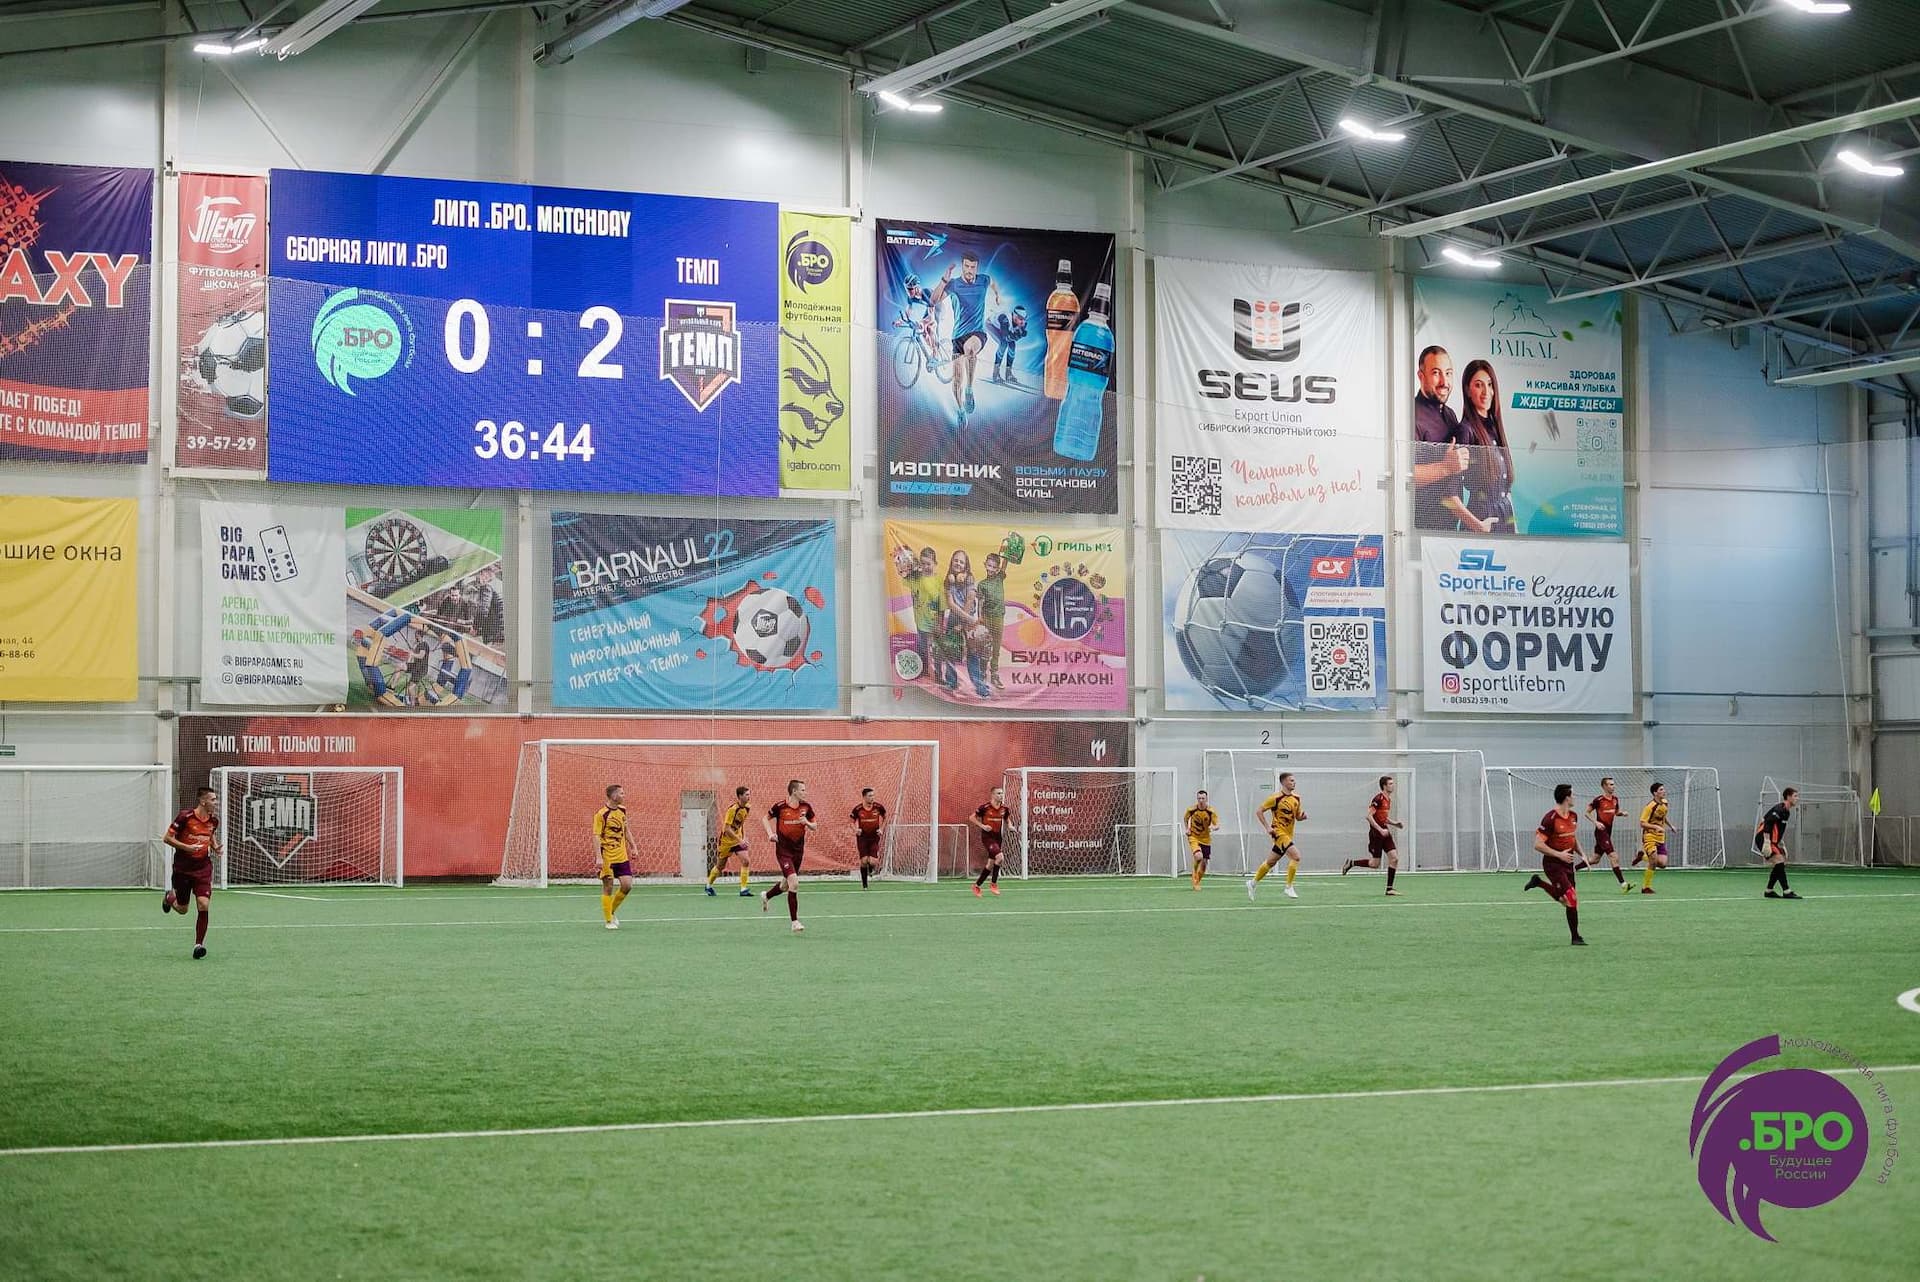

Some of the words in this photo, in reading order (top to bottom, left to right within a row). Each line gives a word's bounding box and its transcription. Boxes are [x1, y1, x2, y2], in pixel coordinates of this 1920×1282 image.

[432, 198, 480, 228] ЛИГА
[484, 202, 533, 232] .БРО.
[536, 205, 633, 238] MATCHDAY
[285, 236, 362, 264] СБОРНАЯ
[365, 239, 409, 267] ЛИГИ
[411, 243, 449, 270] .БРО
[797, 253, 830, 269] .БРО
[188, 265, 258, 279] ФУТБОЛЬНАЯ
[676, 256, 720, 286] ТЕМП
[203, 279, 241, 291] ШКОЛА
[784, 311, 843, 324] футбольная
[336, 326, 394, 350] .БРО
[819, 324, 842, 335] лига
[444, 299, 491, 374] 0
[577, 305, 624, 379] 2
[668, 331, 734, 371] ТЕМП
[1569, 369, 1616, 381] ЗДОРОВАЯ
[1197, 368, 1337, 404] SEUS
[1526, 380, 1533, 390] И
[1534, 381, 1580, 393] КРАСИВАЯ
[1582, 384, 1616, 394] УЛЫБКА
[33, 395, 81, 418] ПОБЕД!
[1519, 395, 1549, 409] ЖДЕТ
[1552, 397, 1578, 410] ТЕБЯ
[1579, 399, 1616, 412] ЗДЕСЬ!
[1234, 408, 1269, 423] Export
[1271, 411, 1302, 423] Union
[16, 416, 25, 433] С
[28, 417, 100, 441] КОМАНДОЙ
[104, 422, 141, 440] ТЕМП!
[1198, 422, 1251, 434] СИБИРСКИЙ
[1253, 425, 1312, 437] ЭКСПОРТНЫЙ
[1313, 428, 1337, 437] СОЮЗ
[187, 436, 257, 451] 39-57-29
[473, 418, 596, 463] 36:44
[786, 459, 842, 473] ligabro.com
[889, 461, 1001, 479] ИЗОТОНИК
[1015, 466, 1066, 476] ВОЗЬМИ
[1231, 457, 1305, 485] Чемпион
[1015, 478, 1097, 489] ВОССТАНОВИ
[1234, 482, 1305, 508] каждом
[1308, 484, 1327, 504] из
[1330, 469, 1362, 496] нас!
[1016, 488, 1055, 499] СИЛЫ.
[220, 527, 242, 543] BIG
[62, 544, 122, 562] окна
[221, 545, 255, 562] PAPA
[1057, 542, 1092, 551] ГРИЛЬ
[1457, 549, 1506, 571] SL
[222, 563, 266, 581] GAMES
[1439, 573, 1526, 592] SportLife
[1531, 575, 1619, 604] Создаем
[221, 596, 259, 611] АРЕНДА
[221, 613, 290, 628] РАЗВЛЕЧЕНИЙ
[1440, 603, 1615, 628] СПОРТИВНУЮ
[569, 612, 651, 644] ГЕНЕРАЛЬНЫЙ
[221, 629, 236, 641] НА
[238, 630, 265, 643] ВАШЕ
[267, 631, 336, 646] МЕРОПРИЯТИЕ
[570, 630, 681, 669] ИНФОРМАЦИОННЫЙ
[1440, 630, 1614, 673] ФОРМУ
[1011, 651, 1059, 666] БУДЬ
[1064, 651, 1105, 667] КРУТ,
[569, 666, 621, 690] ПАРТНЕР
[624, 663, 643, 678] ФК
[646, 652, 689, 674] «ТЕМП»
[1011, 672, 1043, 684] КАК
[1047, 672, 1114, 687] ДРАКОН!
[235, 674, 304, 686] @BIGPAPAGAMES
[1462, 675, 1566, 695] sportlifebrn
[205, 735, 239, 754] ТЕМП,
[242, 735, 275, 754] ТЕМП,
[278, 736, 321, 753] ТОЛЬКО
[323, 736, 356, 753] ТЕМП!
[1261, 730, 1270, 745] 2
[1033, 790, 1076, 800] fctemp.ru
[251, 797, 310, 830] ТЕМП
[1050, 806, 1073, 815] Темп
[1033, 839, 1103, 850] fctemp_barnaul
